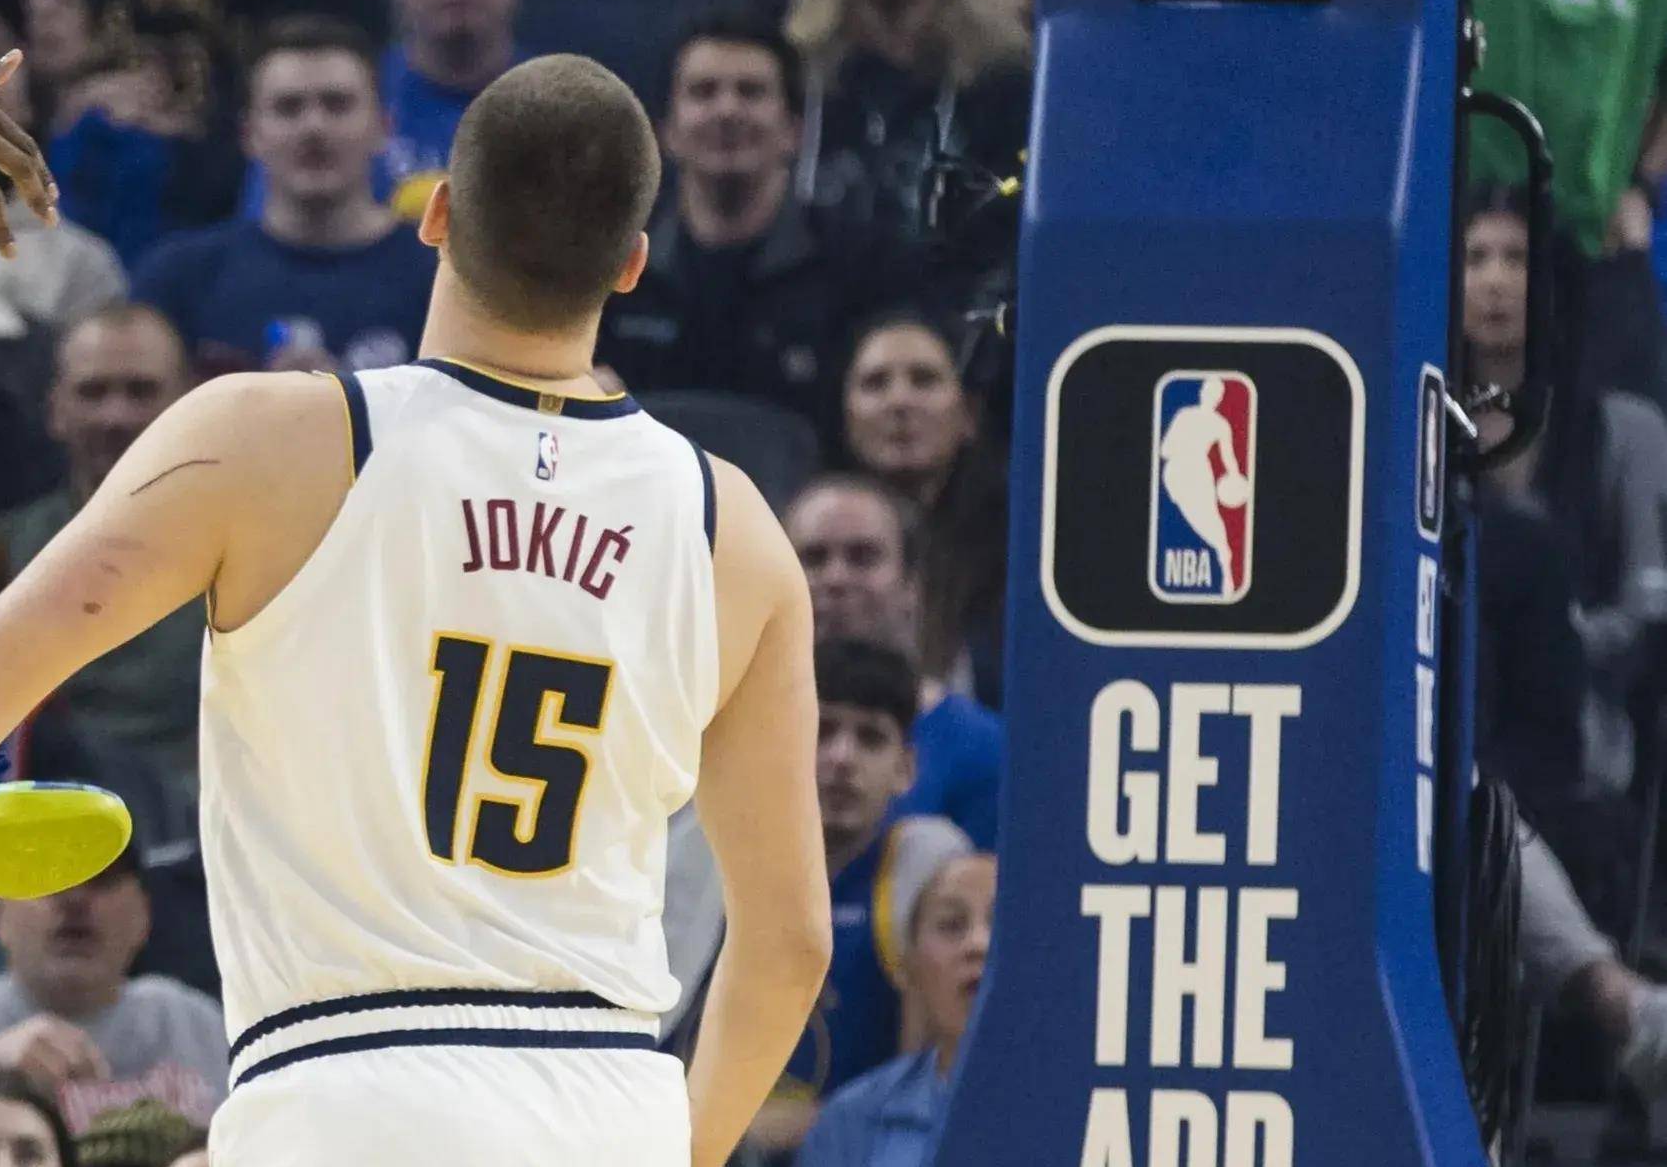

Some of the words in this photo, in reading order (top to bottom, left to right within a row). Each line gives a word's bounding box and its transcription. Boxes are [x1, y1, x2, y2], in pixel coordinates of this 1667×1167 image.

[461, 499, 635, 601] JOKIĆ
[1164, 548, 1212, 587] NBA
[420, 629, 617, 879] 15
[1085, 678, 1302, 866] GET
[1080, 884, 1299, 1070] THE
